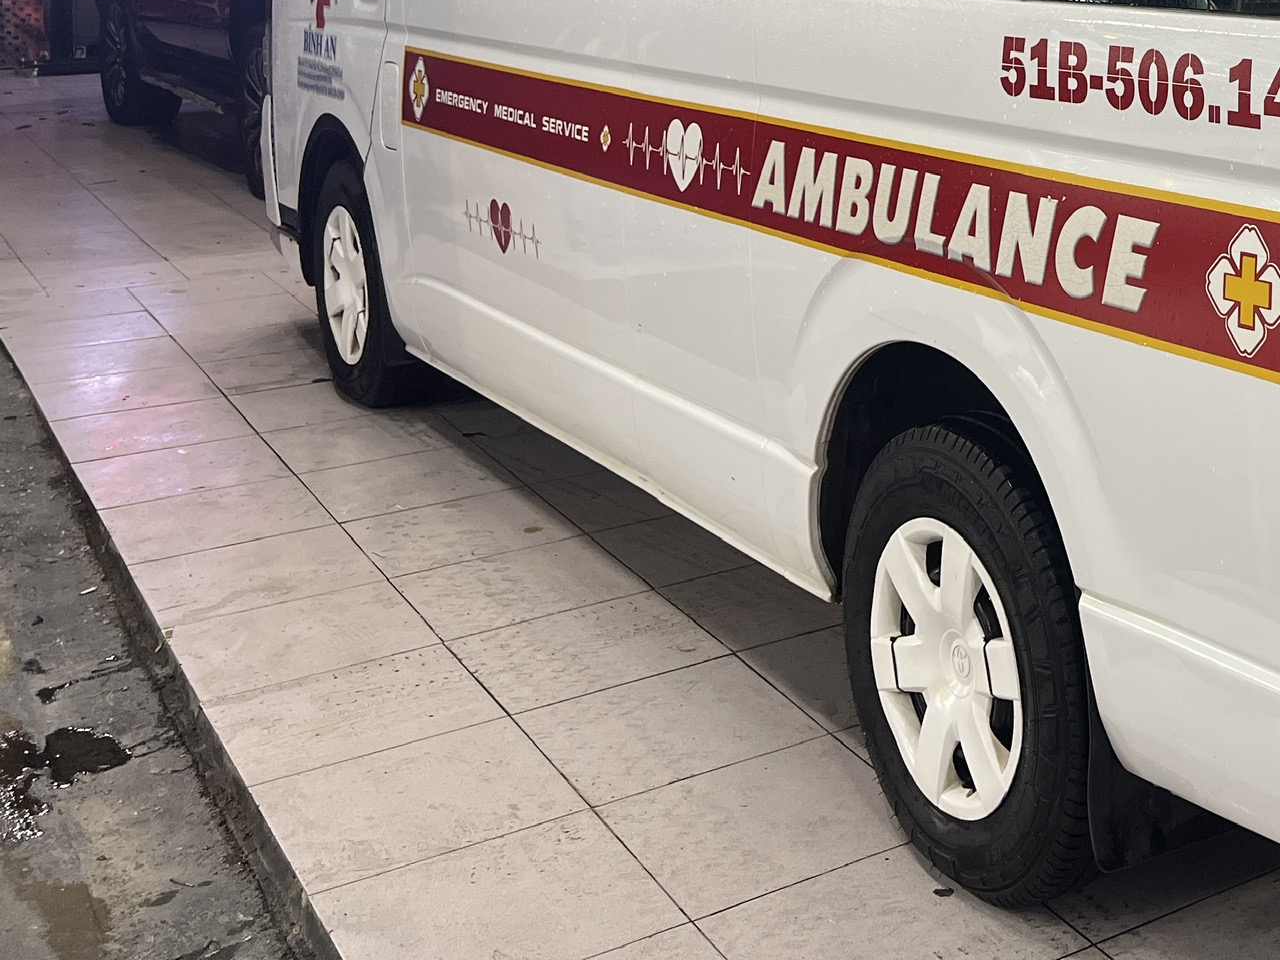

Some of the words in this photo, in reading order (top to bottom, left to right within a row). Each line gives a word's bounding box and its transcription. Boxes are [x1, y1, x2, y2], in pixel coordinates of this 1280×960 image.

[323, 34, 337, 61] AN
[435, 88, 489, 115] EMERGENCY
[493, 104, 537, 128] MEDICAL
[541, 116, 590, 143] SERVICE
[750, 140, 1162, 313] AMBULANCE
